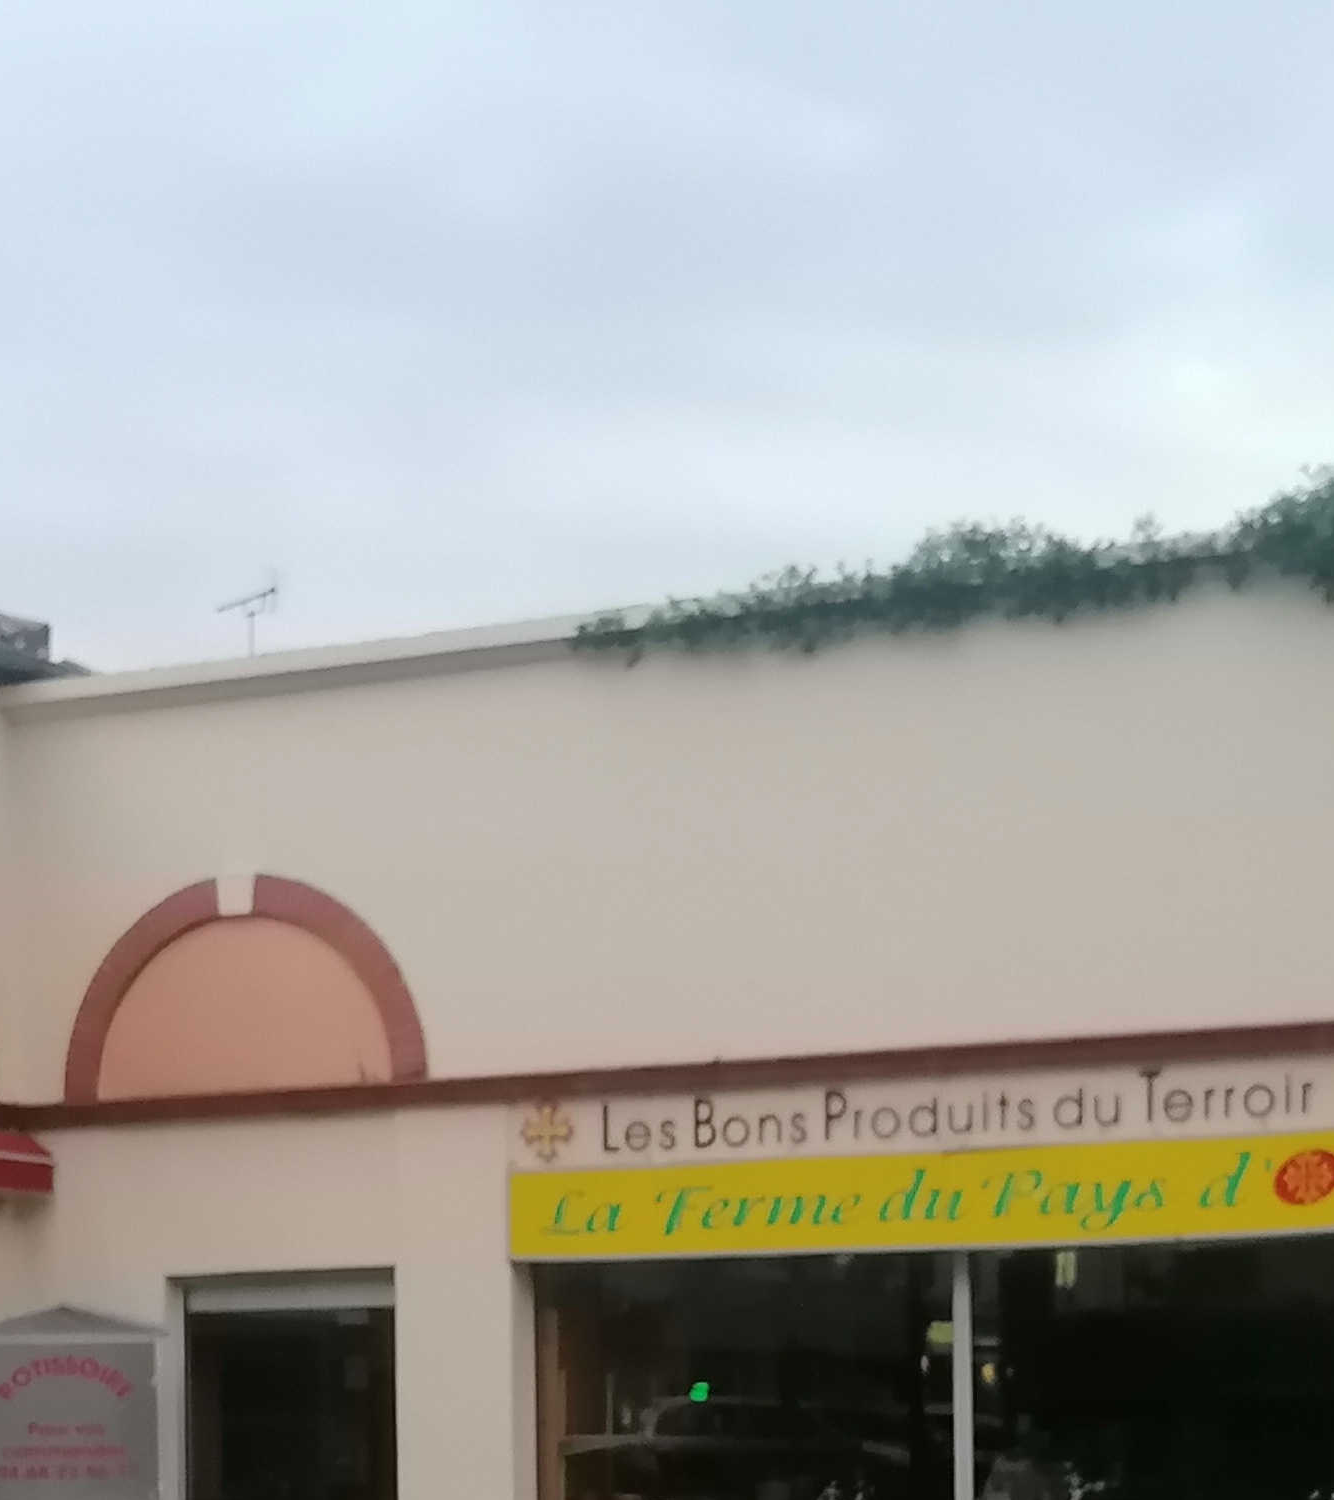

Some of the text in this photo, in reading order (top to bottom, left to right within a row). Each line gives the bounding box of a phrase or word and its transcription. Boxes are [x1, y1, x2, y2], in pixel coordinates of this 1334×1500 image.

[601, 1066, 1313, 1152] Les Bons Produits du Terroir
[542, 1190, 623, 1236] La
[655, 1186, 863, 1236] Ferme
[878, 1168, 964, 1223] du
[981, 1170, 1165, 1233] Pays
